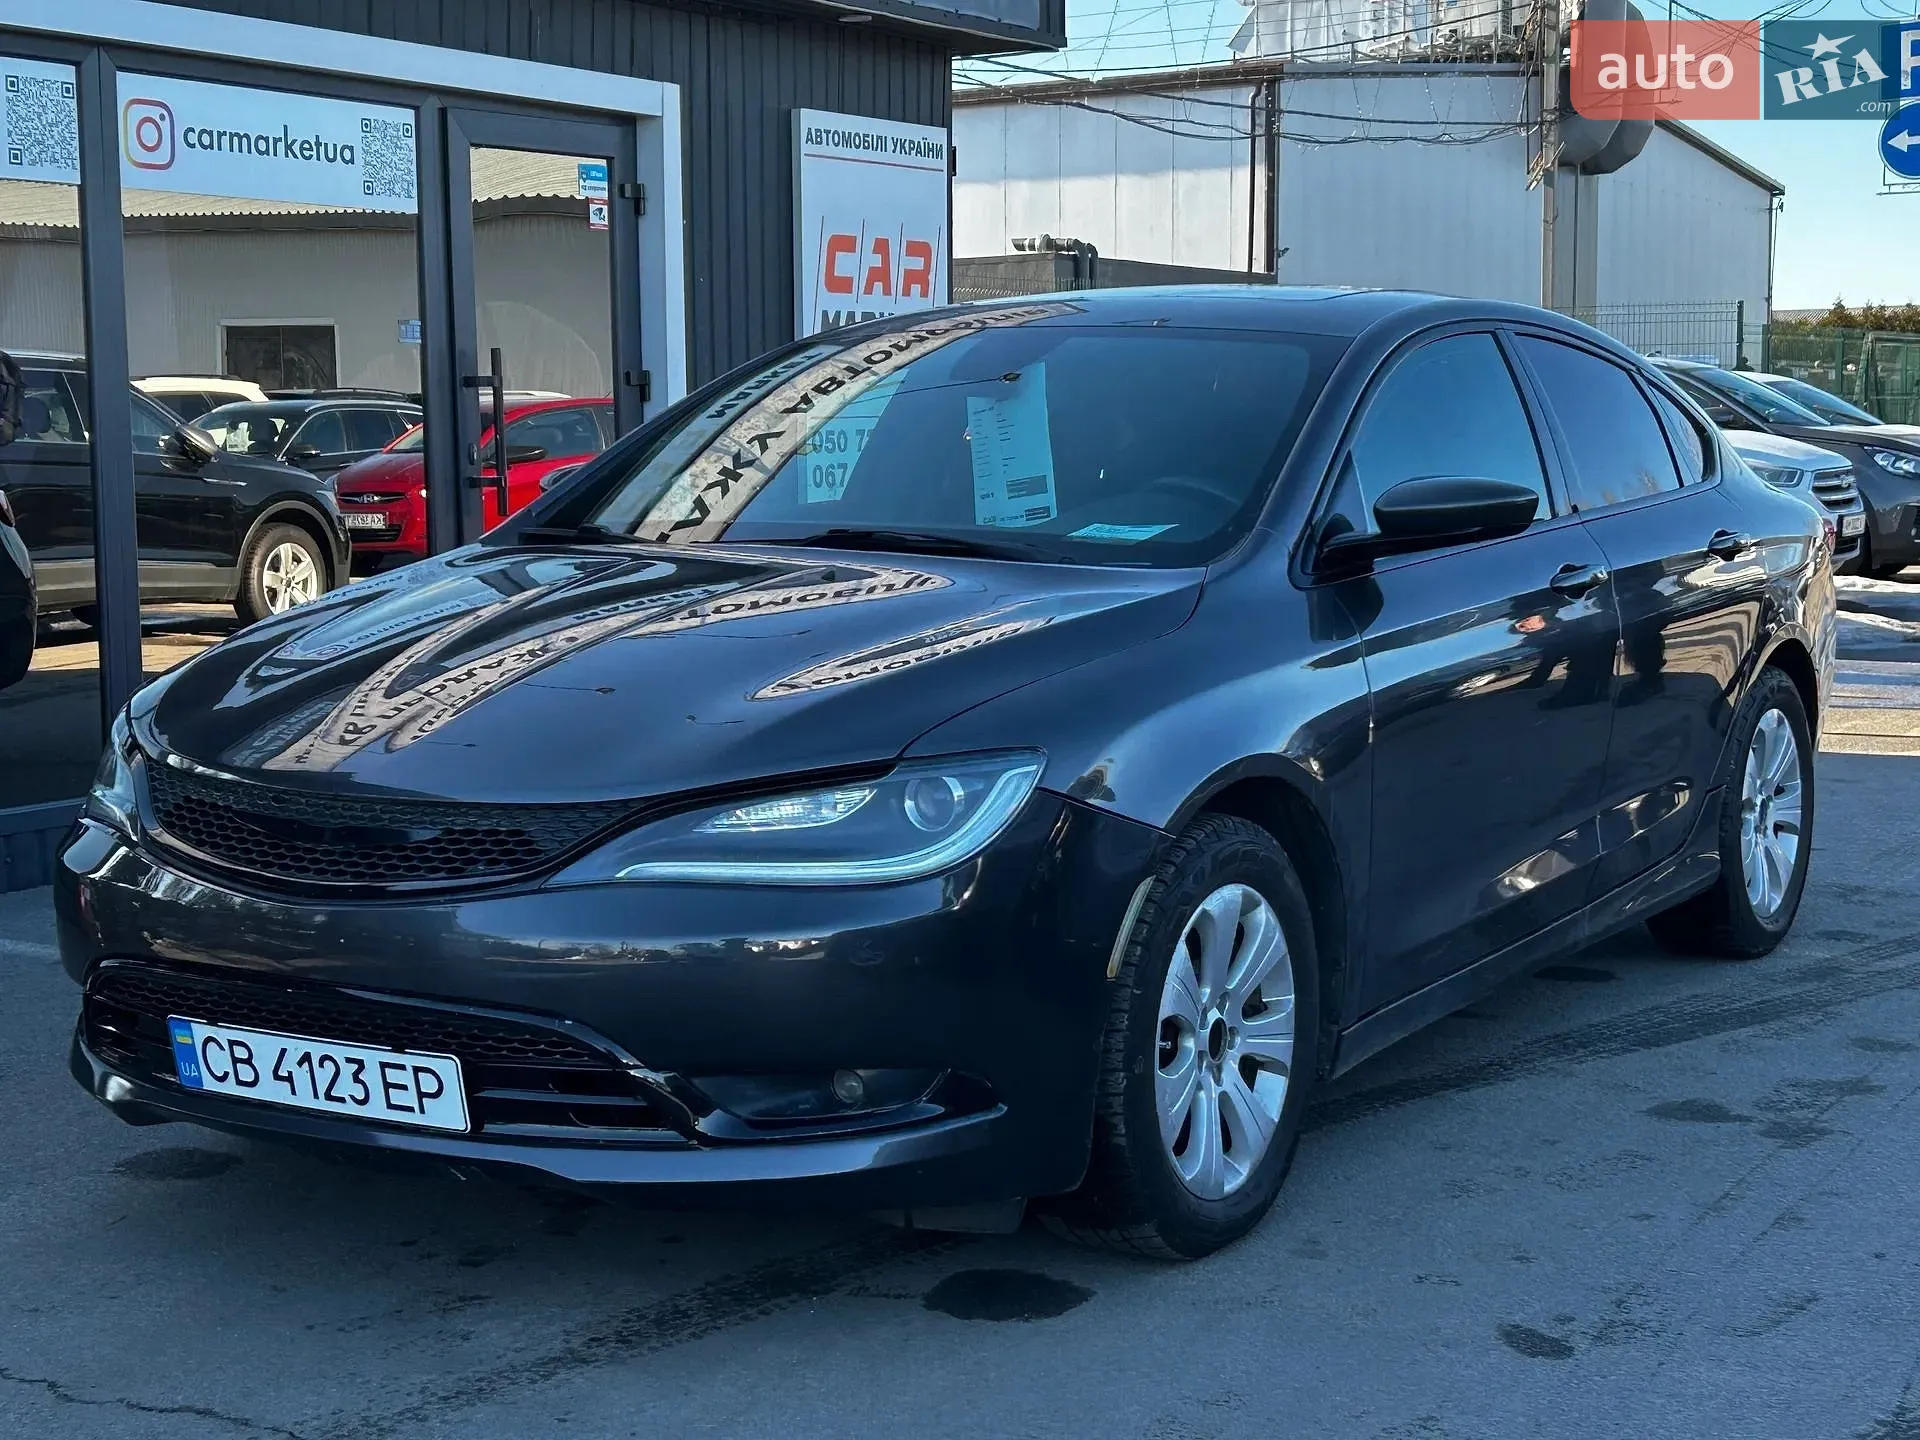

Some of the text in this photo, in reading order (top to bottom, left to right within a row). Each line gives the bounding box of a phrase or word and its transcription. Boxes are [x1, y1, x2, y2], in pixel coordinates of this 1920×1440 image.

[182, 124, 356, 166] carmarketua
[805, 126, 944, 161] АВТОМОБІЛІ УКРАЇНИ
[824, 233, 933, 298] CAR
[811, 429, 848, 454] 050
[812, 463, 848, 488] 067
[181, 1061, 200, 1078] UA
[201, 1035, 444, 1115] CB 4123 EP
